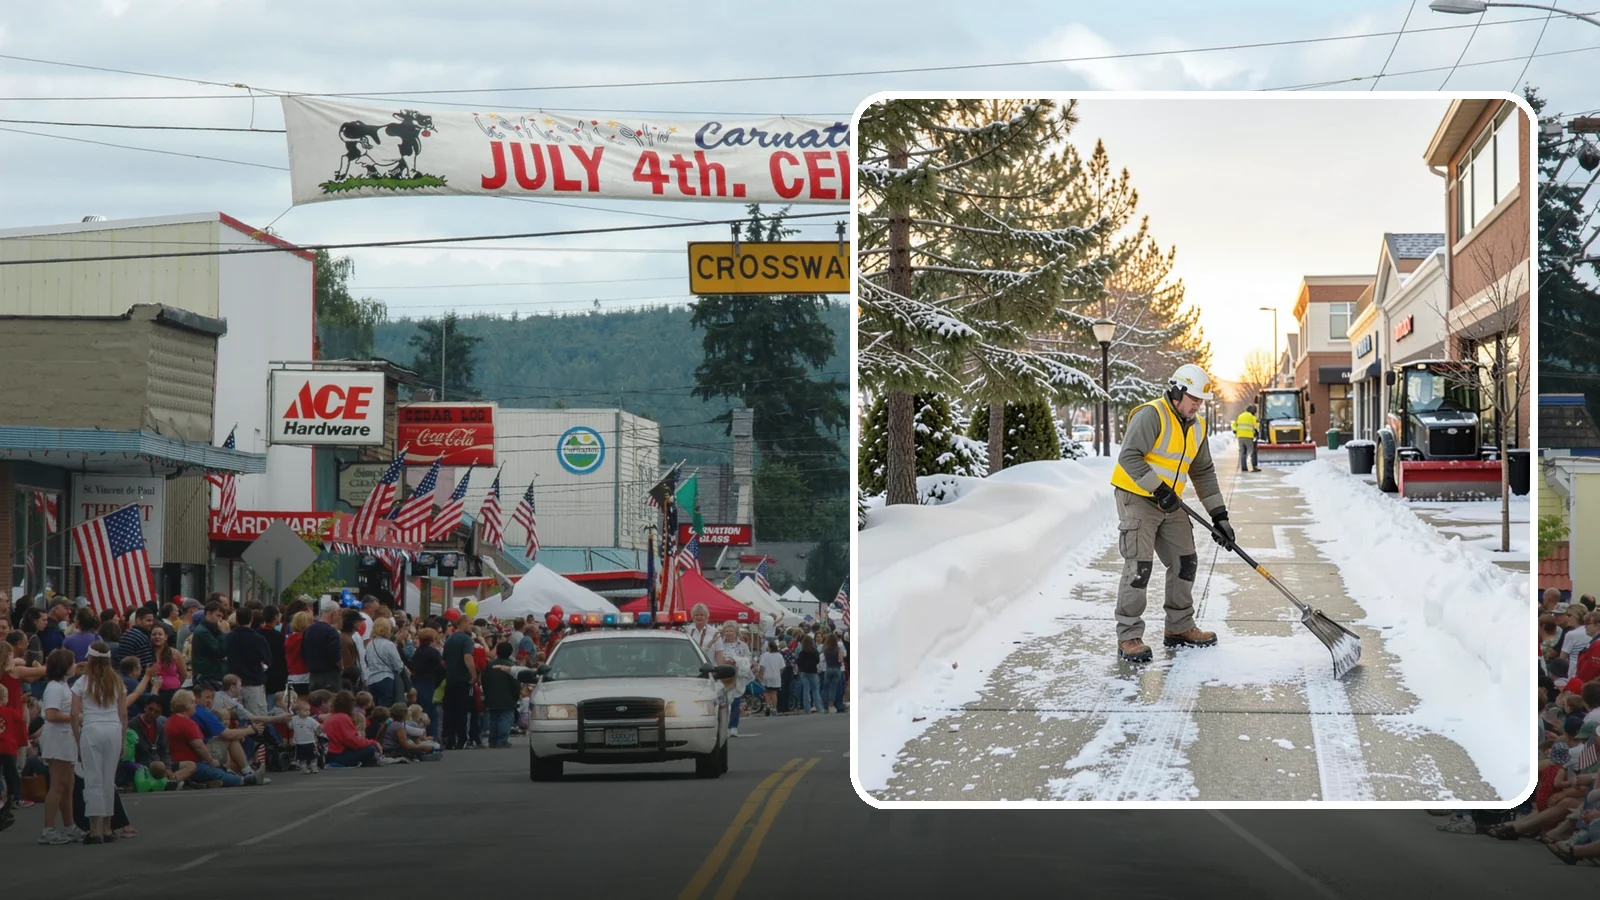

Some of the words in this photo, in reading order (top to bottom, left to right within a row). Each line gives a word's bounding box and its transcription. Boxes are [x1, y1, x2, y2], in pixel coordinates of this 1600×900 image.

[481, 141, 605, 193] JULY
[632, 150, 746, 198] 4th.
[697, 254, 850, 280] CROSSWA
[282, 380, 374, 420] ACE
[405, 409, 453, 422] CEDAR
[461, 410, 485, 422] LOG
[283, 421, 371, 437] Hardware
[416, 428, 477, 447] Coca-Cola
[353, 466, 385, 481] Simpl
[83, 484, 94, 494] St.
[95, 485, 125, 495] Vincent
[126, 486, 136, 495] de
[137, 486, 155, 496] Paul
[688, 526, 741, 535] CRNATION
[699, 535, 730, 543] GLASS
